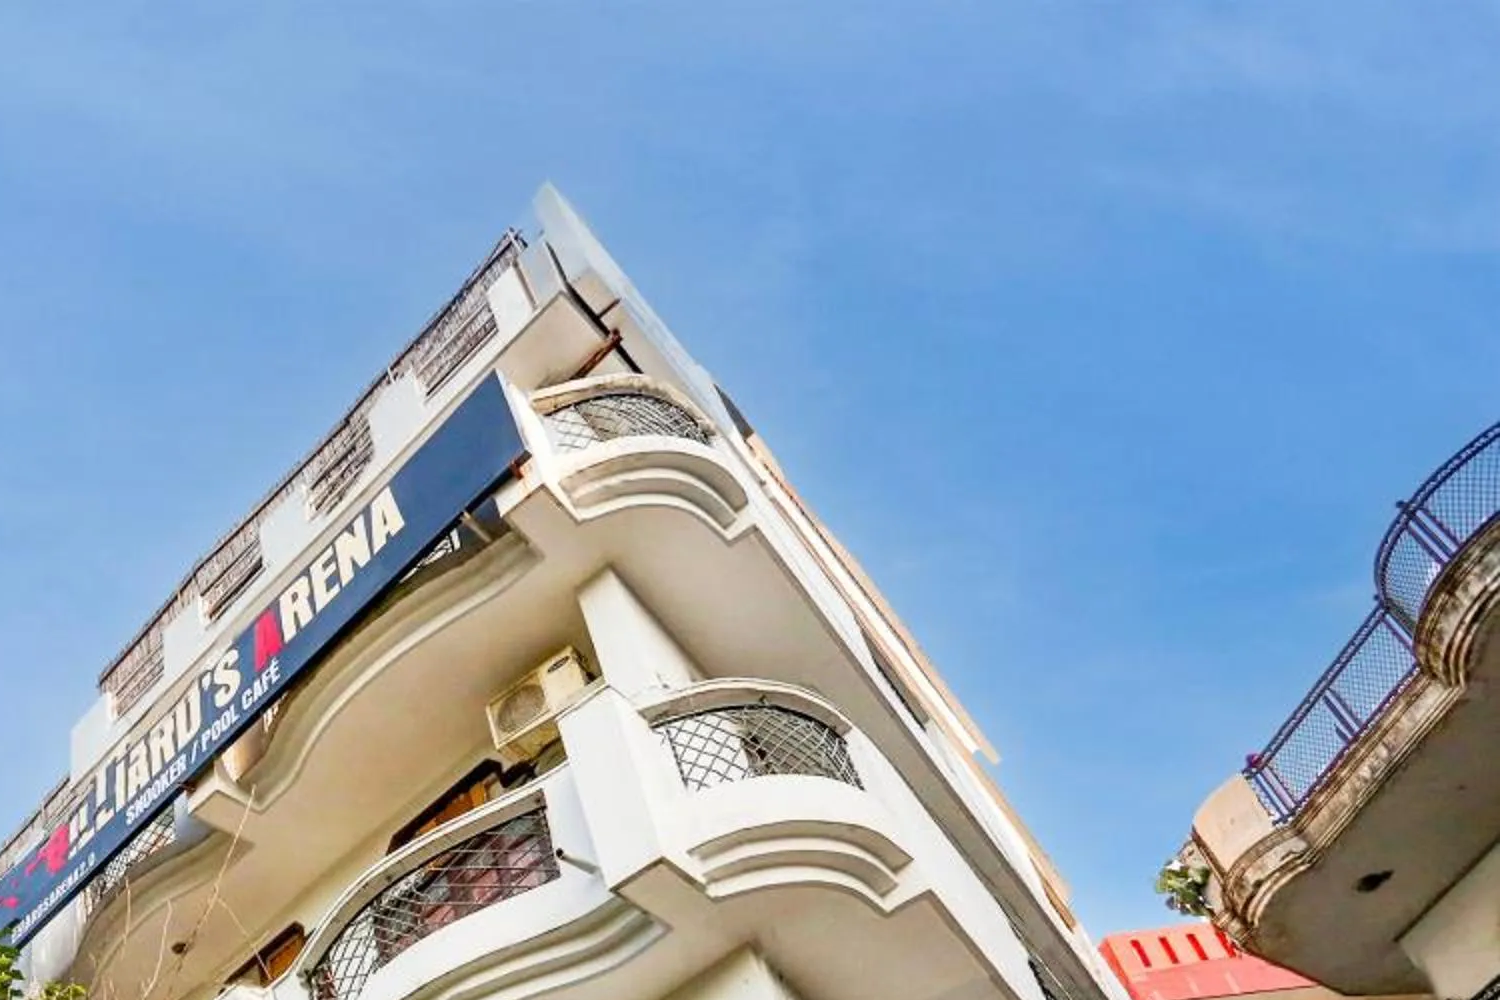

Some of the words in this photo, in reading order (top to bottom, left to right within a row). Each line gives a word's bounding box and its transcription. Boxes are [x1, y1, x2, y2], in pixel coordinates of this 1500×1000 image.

[254, 486, 405, 673] ARENA
[125, 755, 187, 825] SNOOKER
[201, 704, 240, 751] POOL
[241, 656, 281, 710] CAFÉ
